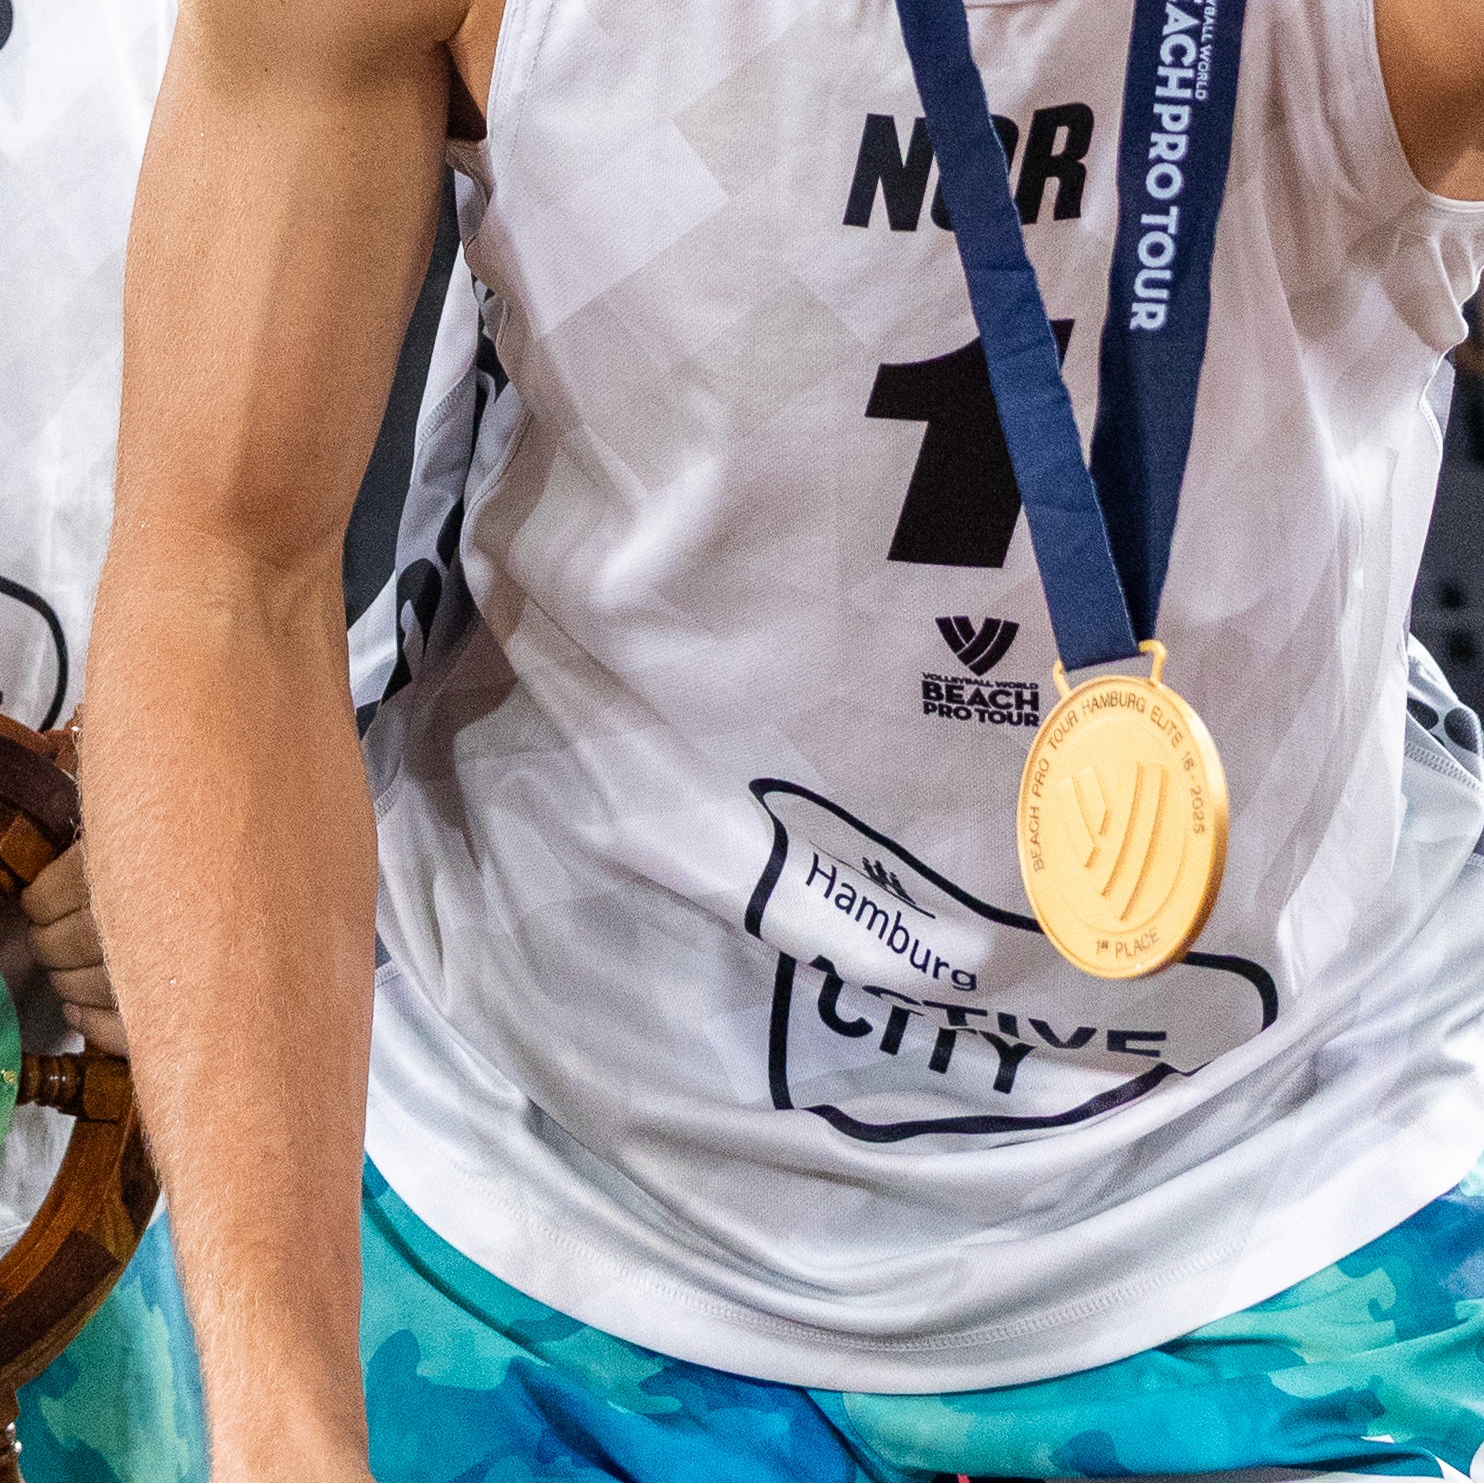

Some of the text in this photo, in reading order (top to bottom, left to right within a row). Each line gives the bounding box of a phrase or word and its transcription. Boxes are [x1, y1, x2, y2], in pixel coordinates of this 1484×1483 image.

[1195, 44, 1214, 101] WORLD
[1146, 103, 1191, 200] PRO
[1130, 206, 1179, 330] TOUR
[922, 672, 1039, 690] VOLLEYBALL WORLD
[922, 680, 1039, 712] BEACH
[923, 701, 1040, 727] PRO TOUR
[1081, 690, 1145, 716] HAMBURG
[1046, 710, 1079, 750] TOUR
[1150, 706, 1183, 748] ELITE
[1031, 757, 1049, 798] PRO
[1190, 784, 1205, 835] 2025
[1028, 805, 1044, 873] BEACH
[805, 852, 978, 992] Hamburg
[1114, 925, 1159, 959] PLACE
